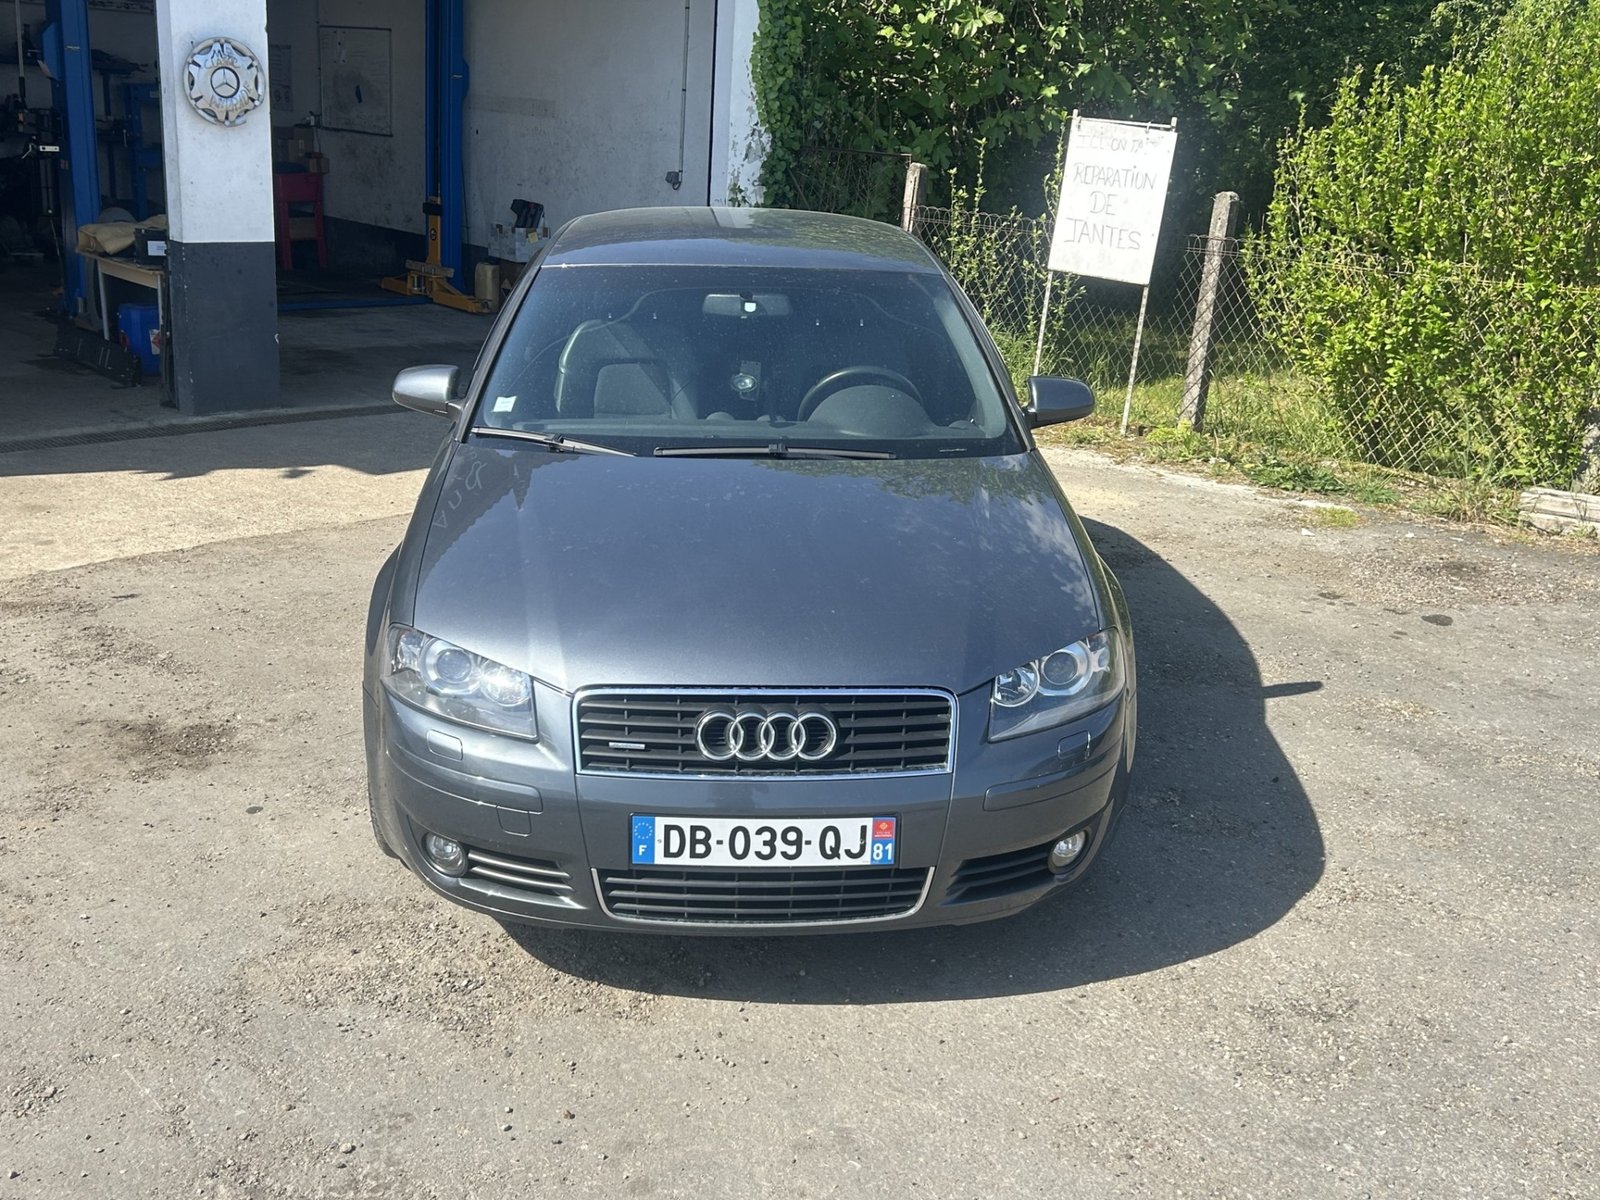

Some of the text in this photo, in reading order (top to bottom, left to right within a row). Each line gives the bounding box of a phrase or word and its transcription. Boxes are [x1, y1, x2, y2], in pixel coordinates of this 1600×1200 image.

[1111, 137, 1128, 151] ON
[1089, 190, 1118, 216] DE
[1064, 217, 1142, 250] JANTES
[639, 845, 647, 855] F
[663, 824, 868, 861] DB-039-QJ
[872, 842, 893, 861] 81
